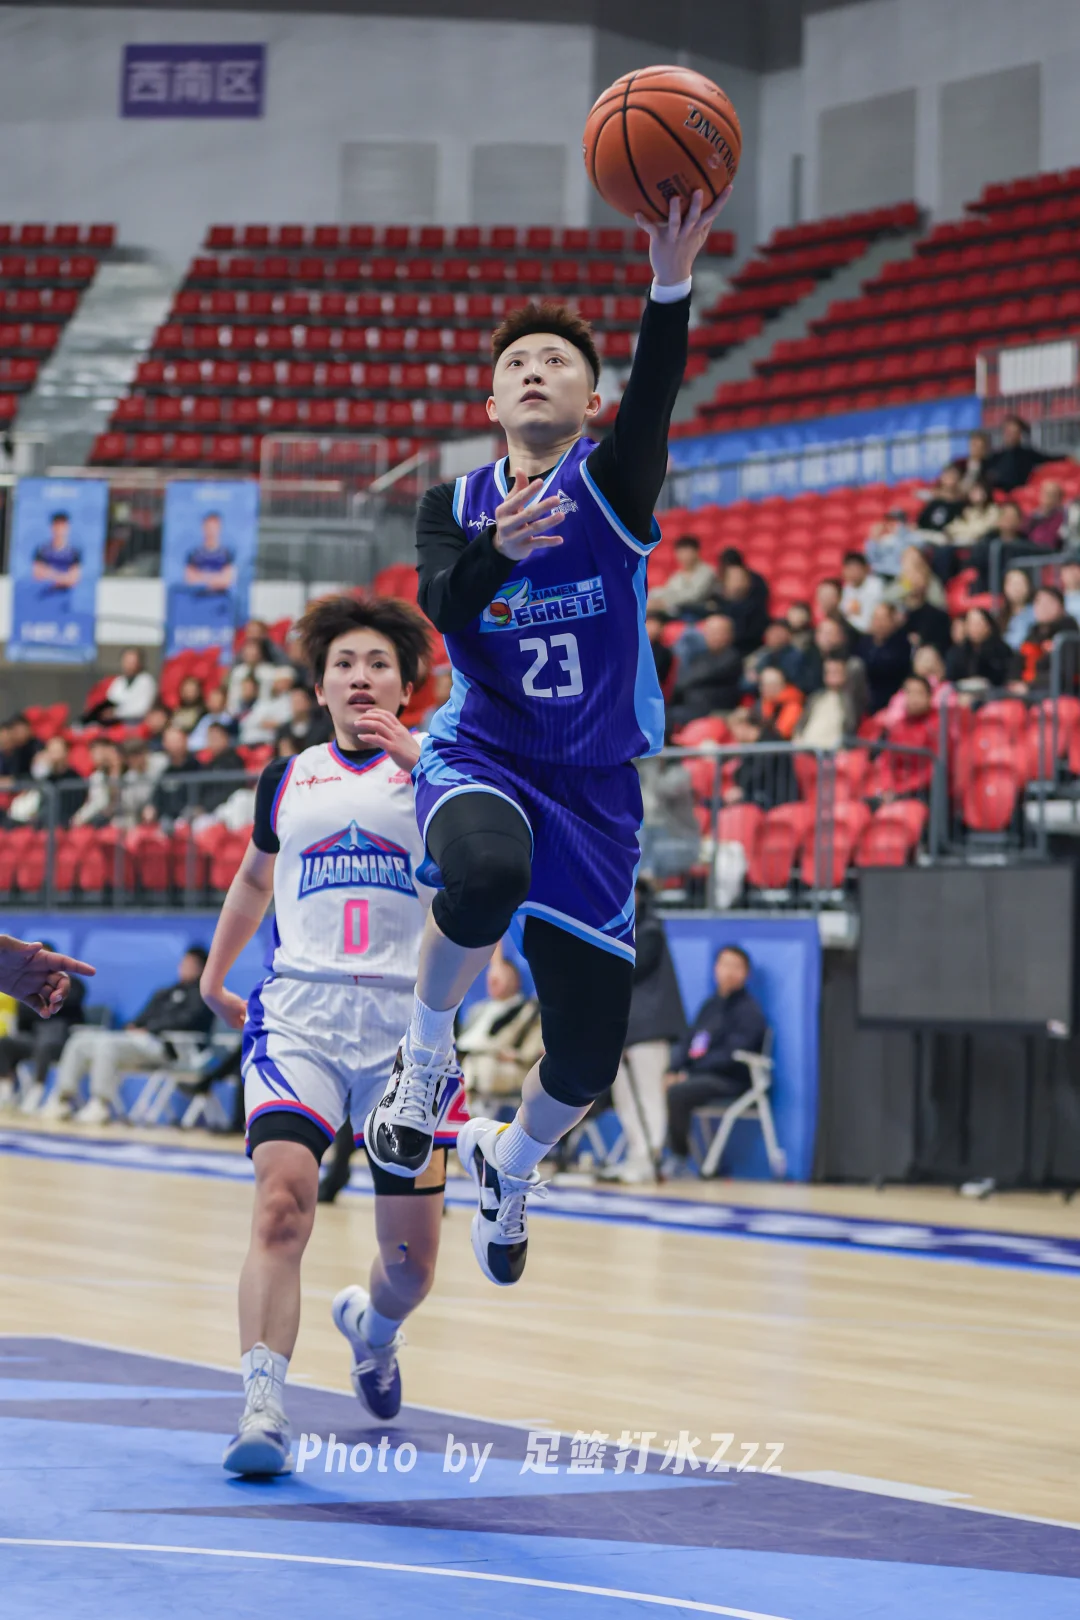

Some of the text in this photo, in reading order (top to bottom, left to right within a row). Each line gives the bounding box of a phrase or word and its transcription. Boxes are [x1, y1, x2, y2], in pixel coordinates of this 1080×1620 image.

[128, 61, 258, 103] 西南区
[514, 592, 606, 627] EGRETS
[531, 584, 577, 600] XIAMEN
[519, 633, 583, 697] 23
[302, 855, 413, 892] LIAONING
[344, 899, 369, 954] 0
